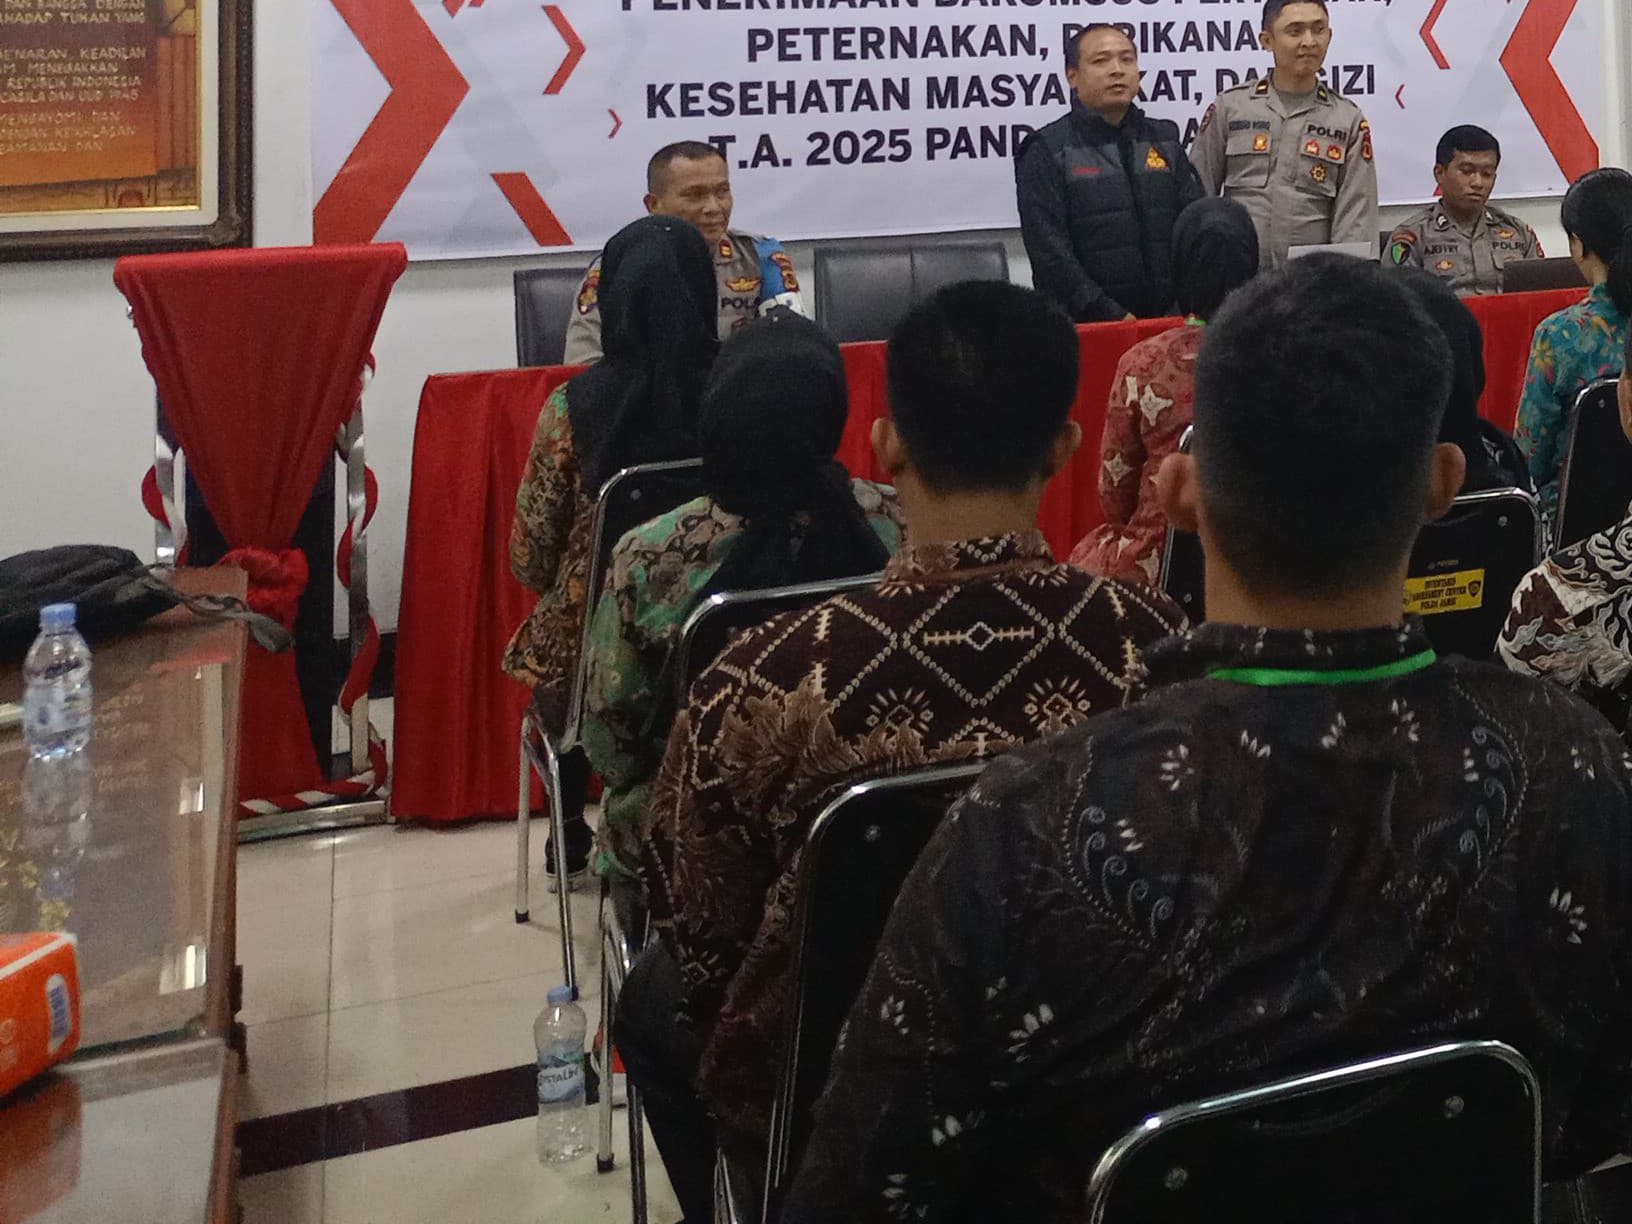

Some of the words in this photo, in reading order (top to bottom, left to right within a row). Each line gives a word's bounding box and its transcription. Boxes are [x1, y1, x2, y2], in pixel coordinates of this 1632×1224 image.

[747, 23, 1050, 63] PETERNAKAN,
[646, 77, 910, 119] KESEHATAN
[1215, 67, 1276, 96] DA
[708, 133, 793, 169] T.A.
[805, 128, 913, 167] 2025
[926, 124, 1036, 162] PAND
[1307, 123, 1348, 142] POLRI
[721, 297, 758, 309] POL
